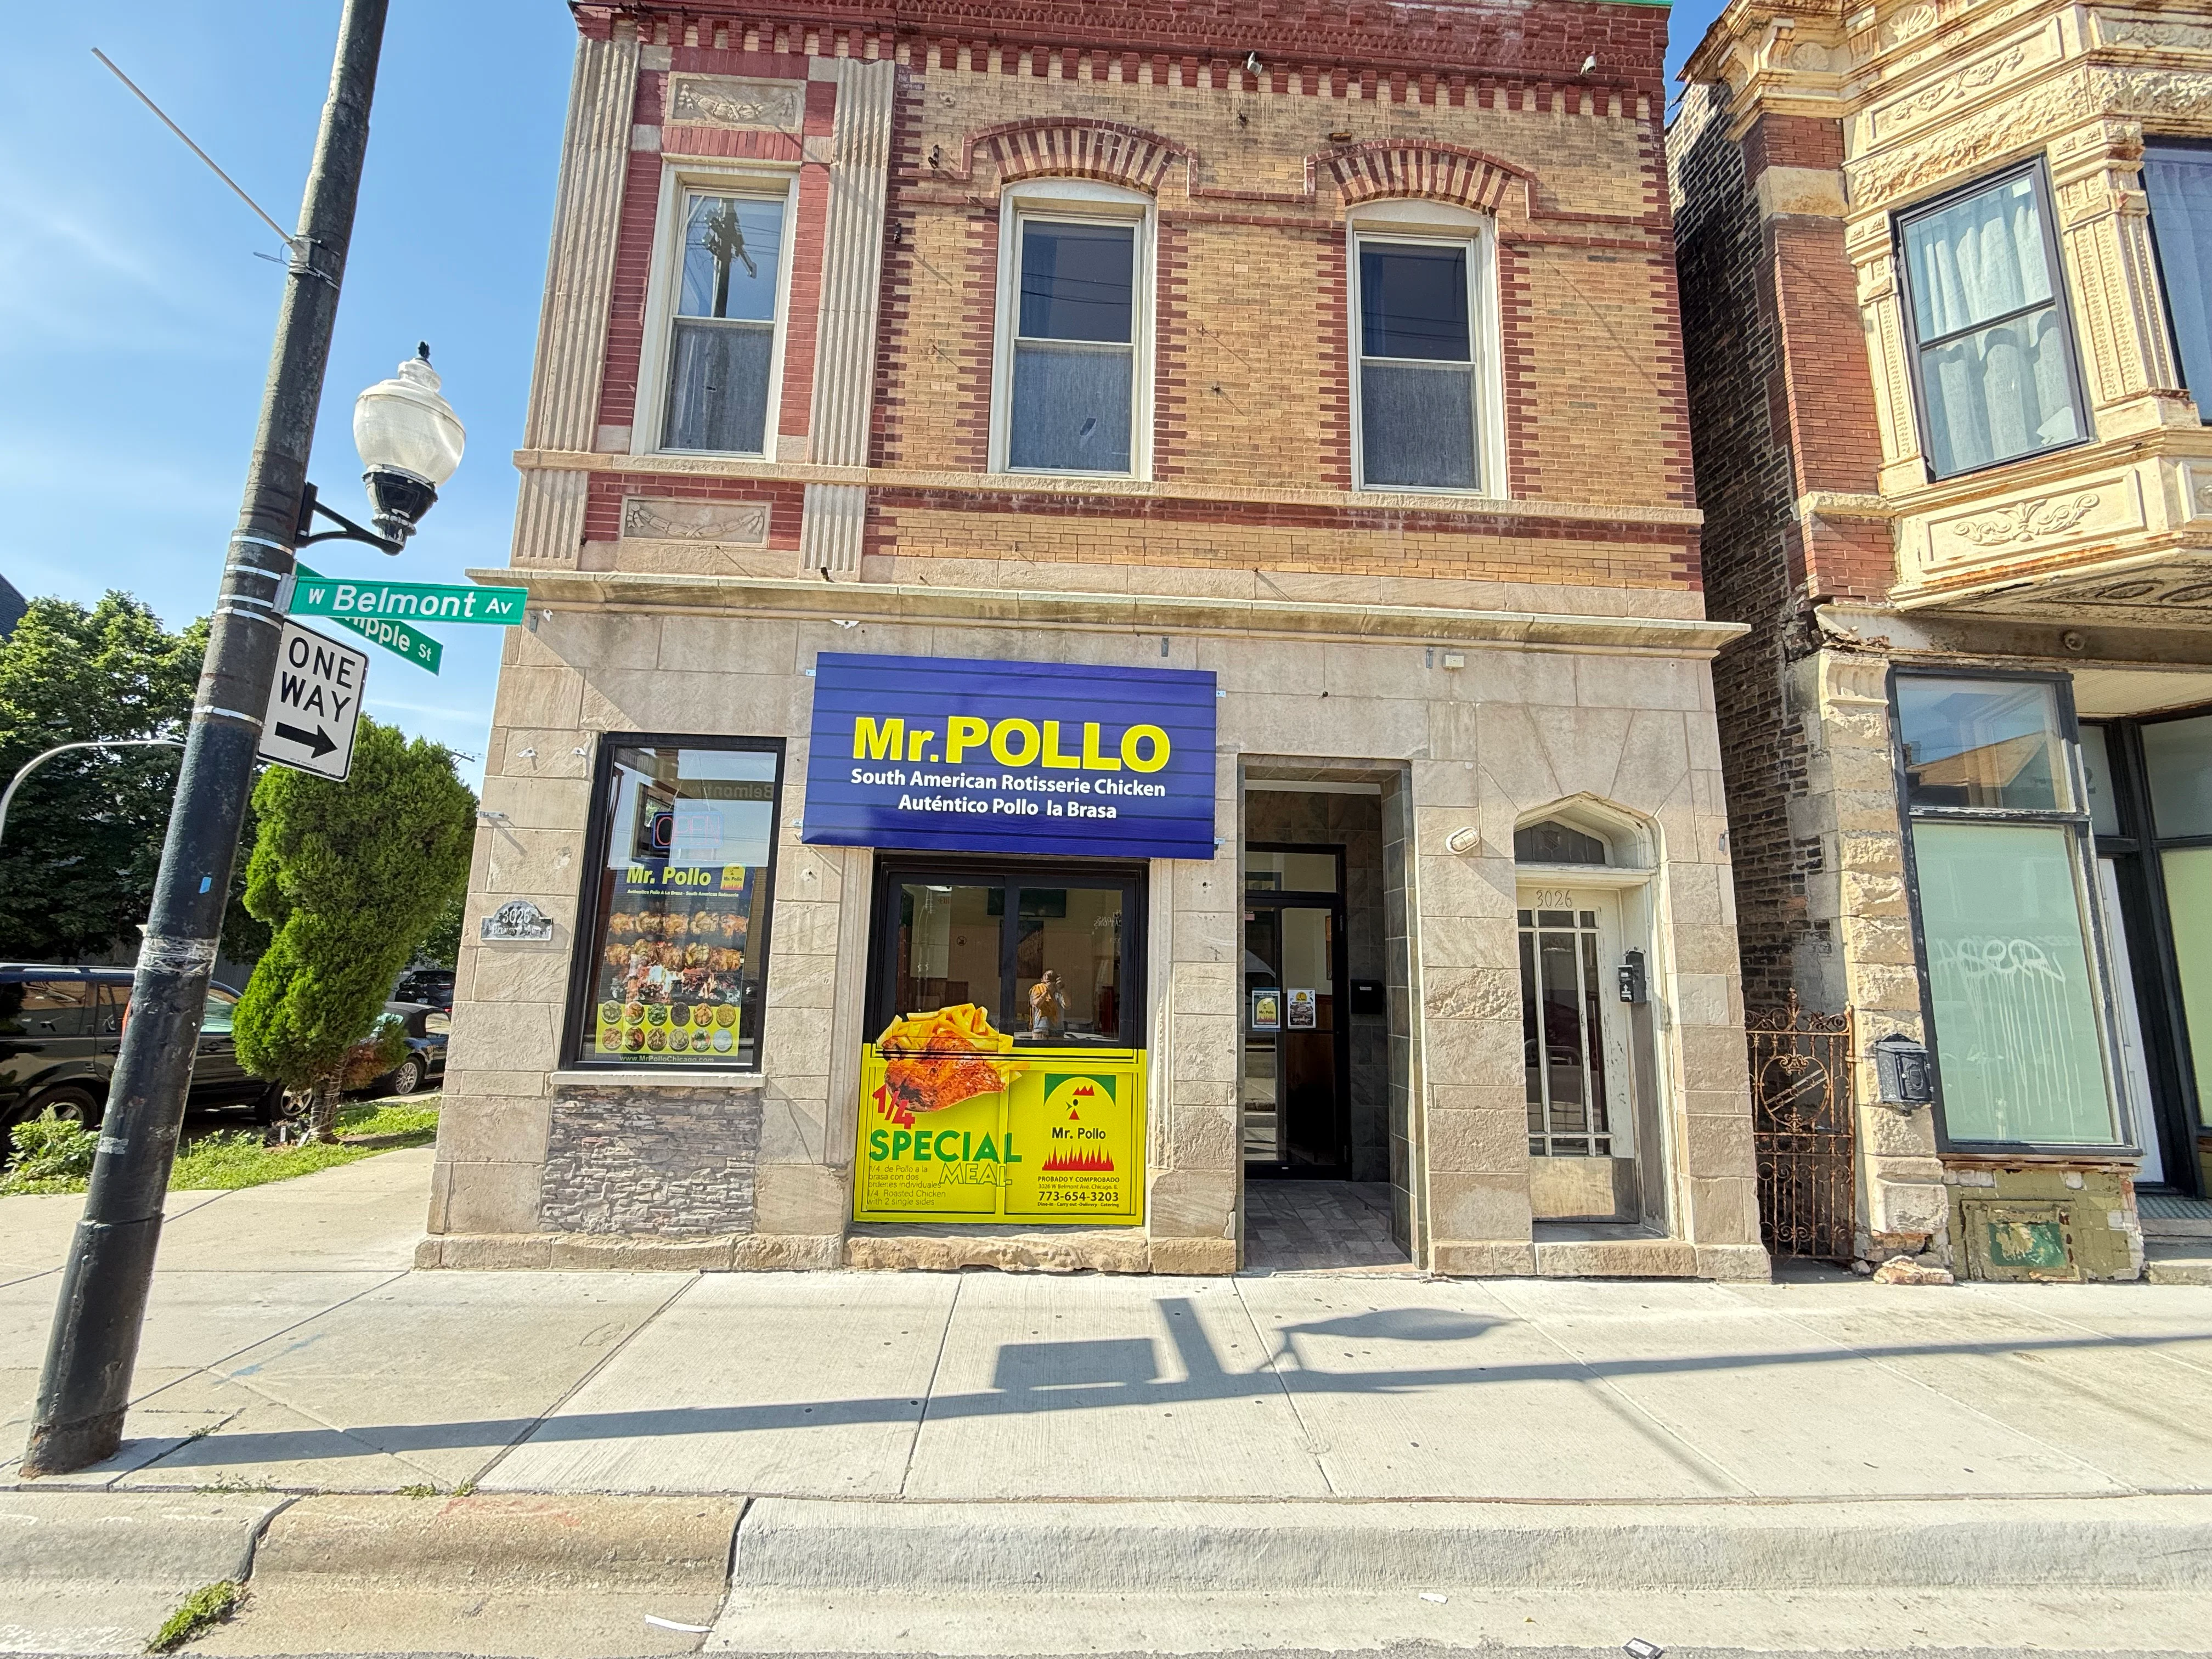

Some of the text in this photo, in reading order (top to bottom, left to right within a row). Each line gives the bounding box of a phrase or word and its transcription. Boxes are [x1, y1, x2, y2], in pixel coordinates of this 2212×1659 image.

[308, 585, 514, 618] W Belmont Av
[289, 637, 356, 690] ONE
[418, 643, 432, 662] St
[280, 670, 352, 723] WAY
[851, 768, 1166, 797] South American Rotisserie Chicken
[898, 794, 1117, 819] Auténtico Pollo la Brasa
[656, 816, 720, 845] OPEN
[626, 865, 711, 886] Mr. Pollo
[1536, 889, 1572, 908] 3026
[502, 909, 531, 924] 3026
[872, 1084, 916, 1130] 1/4
[1052, 1127, 1107, 1139] Mr. Pollo
[869, 1129, 1023, 1164] SPECIAL
[939, 1161, 1013, 1187] MEAL
[884, 1189, 913, 1197] Roasted
[916, 1189, 946, 1198] Chicken
[891, 1198, 913, 1206] single
[1039, 1191, 1119, 1201] 773-654-3203
